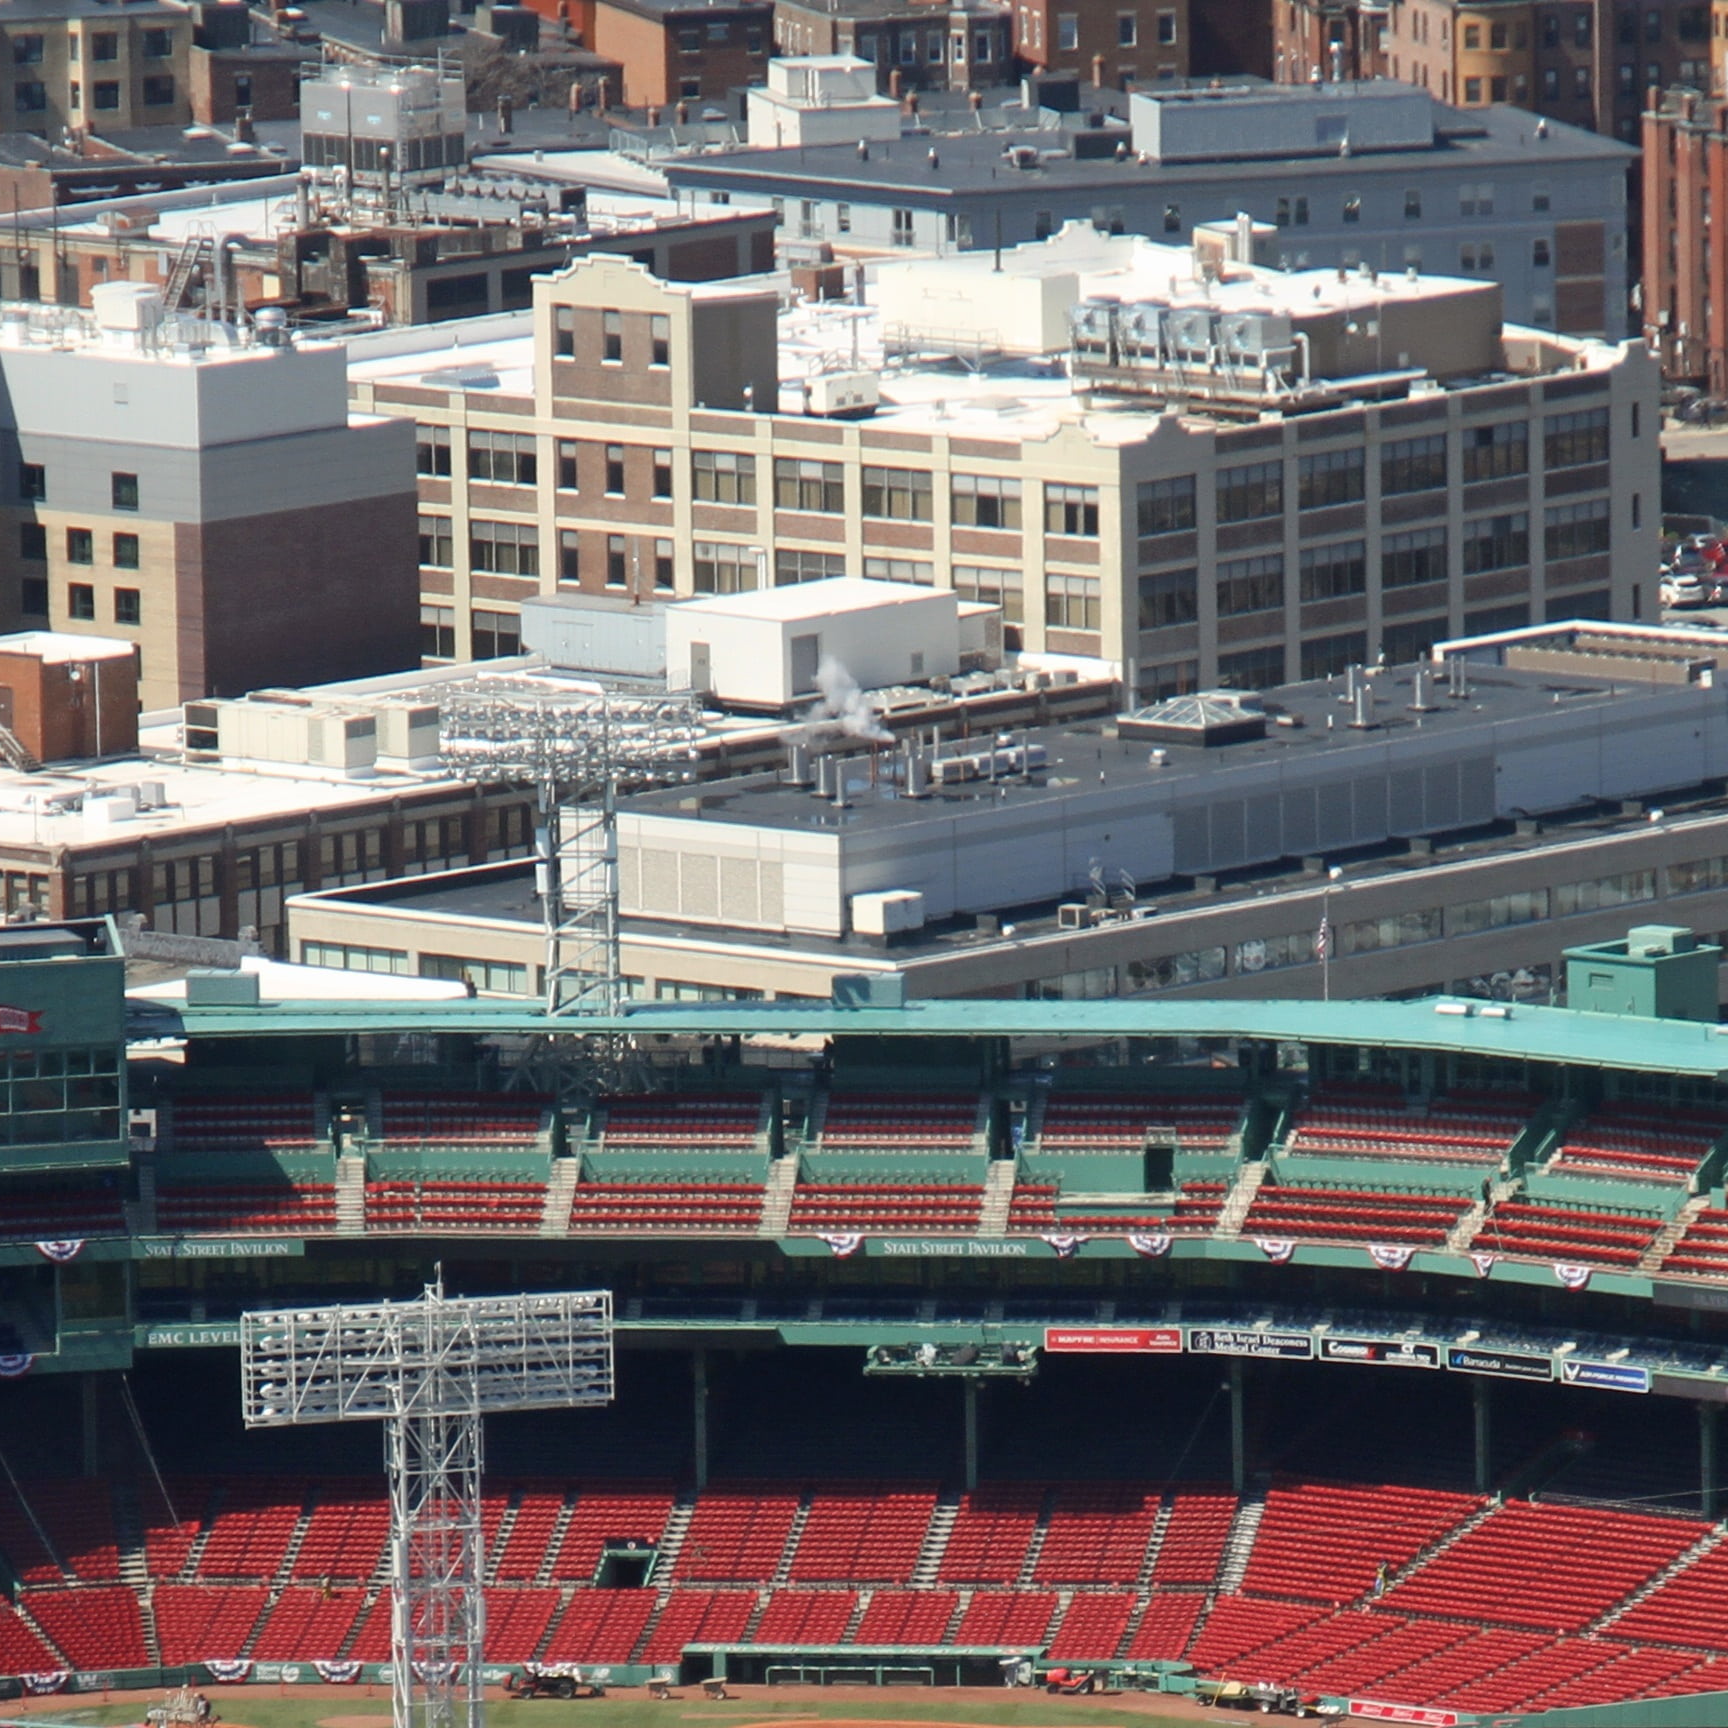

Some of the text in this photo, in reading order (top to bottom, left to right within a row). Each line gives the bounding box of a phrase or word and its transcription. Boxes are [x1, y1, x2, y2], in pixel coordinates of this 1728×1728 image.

[183, 1242, 226, 1257] STREET
[230, 1242, 289, 1256] PAVILION
[884, 1240, 1026, 1255] STATE STREET PAVILION
[148, 1331, 184, 1345] EMC
